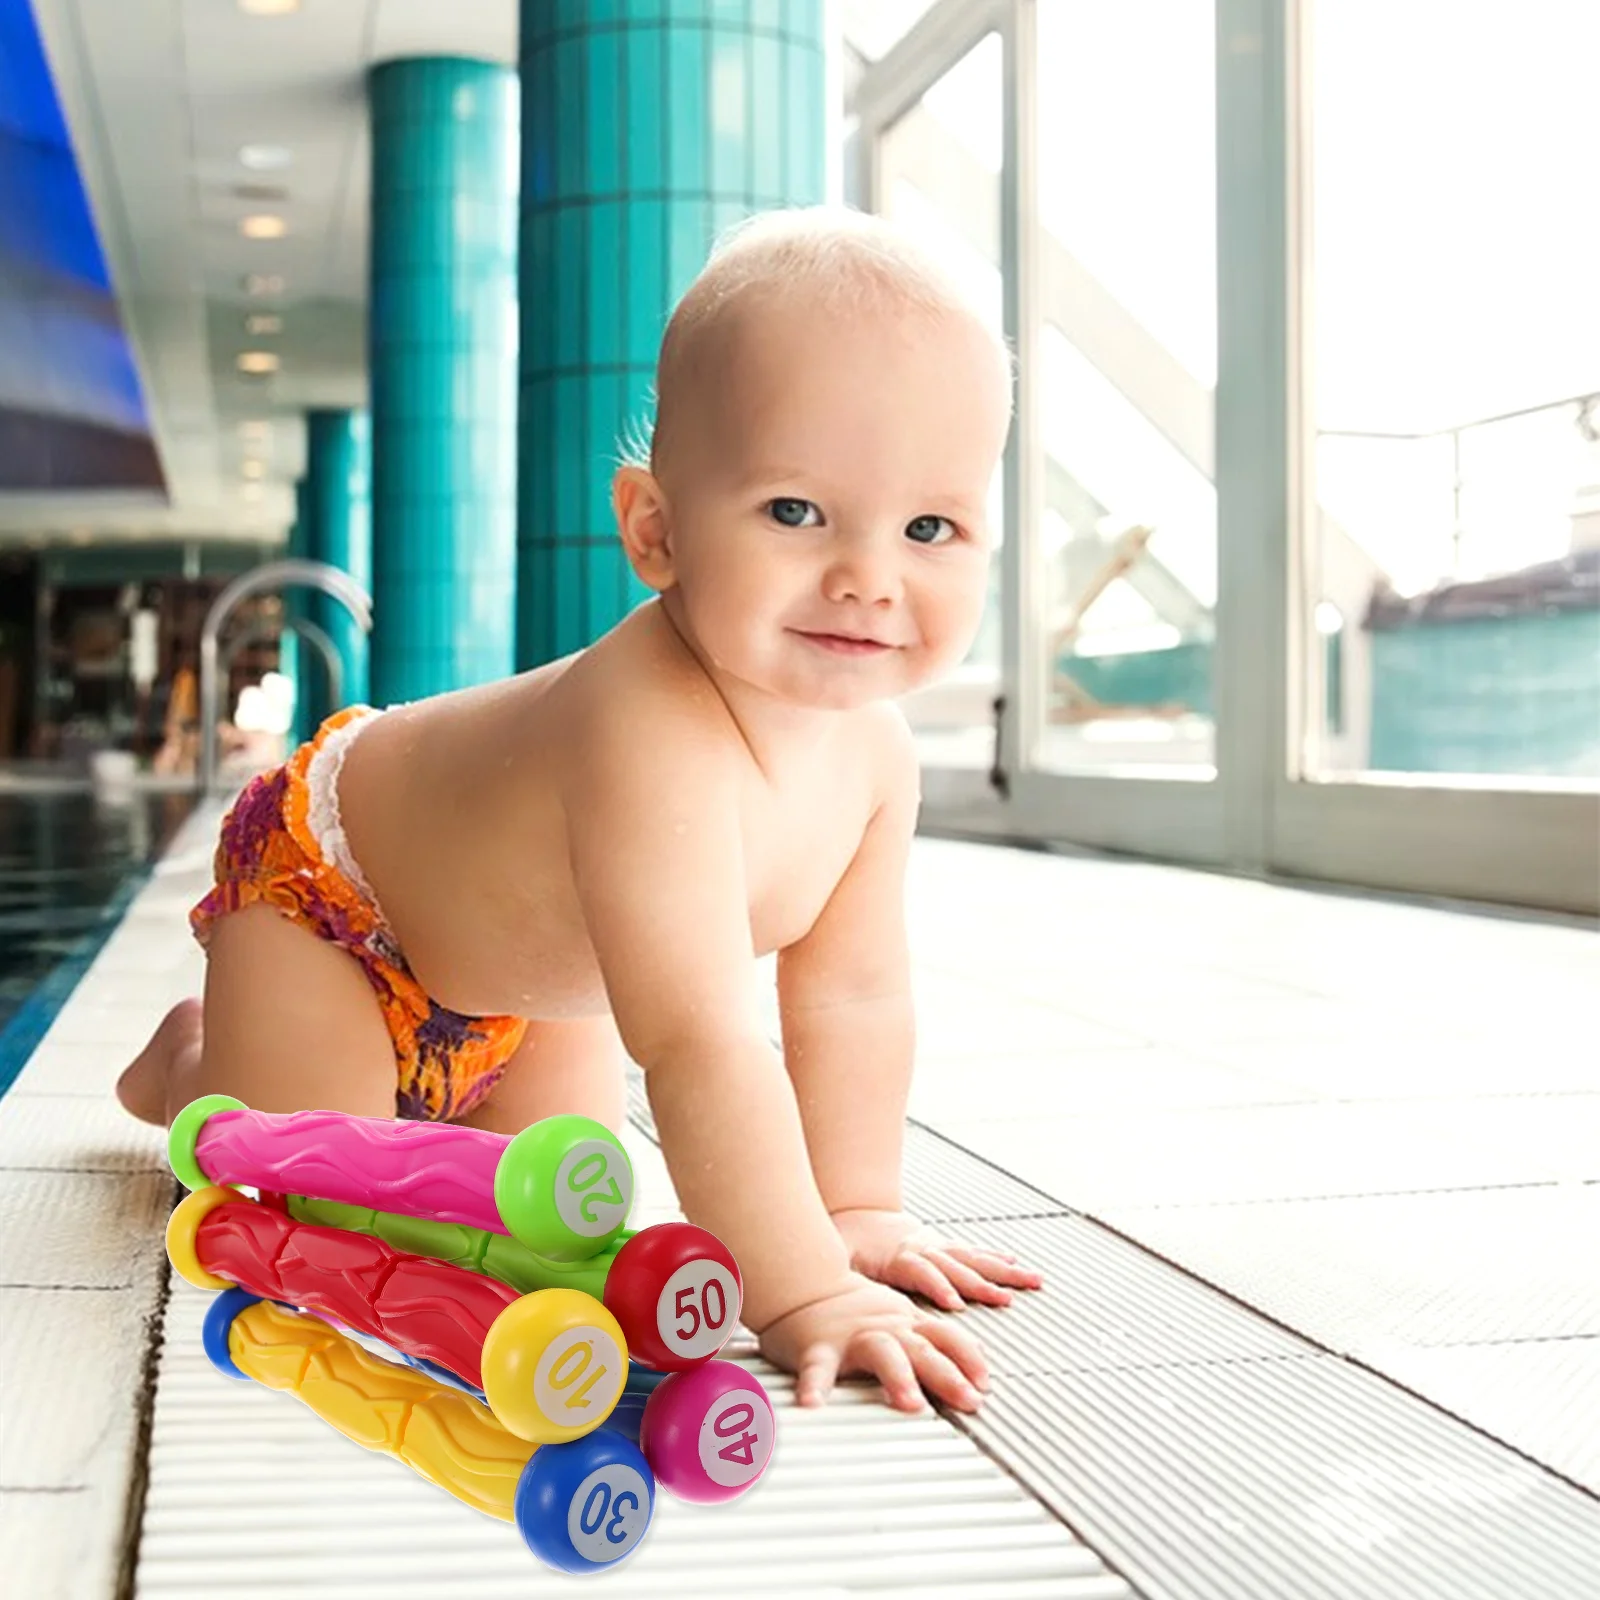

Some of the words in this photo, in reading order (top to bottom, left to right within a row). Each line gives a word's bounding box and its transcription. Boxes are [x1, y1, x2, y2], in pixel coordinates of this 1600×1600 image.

[567, 1152, 624, 1223] 20
[675, 1278, 726, 1340] 50
[547, 1341, 607, 1409] 10
[713, 1402, 758, 1466] 40
[579, 1482, 639, 1544] 30
